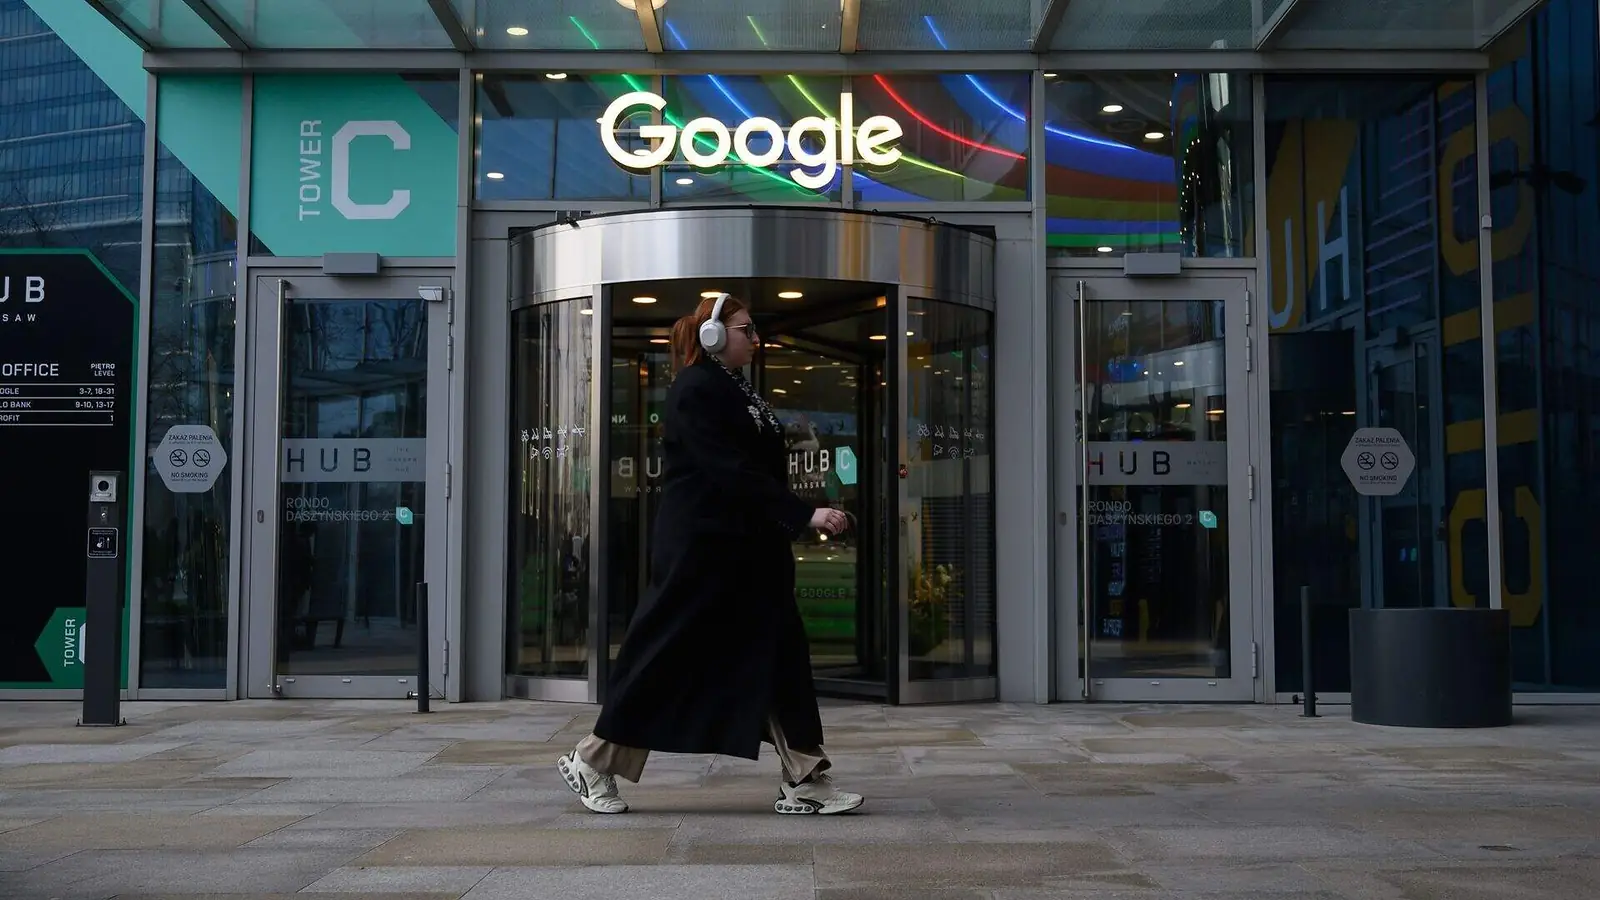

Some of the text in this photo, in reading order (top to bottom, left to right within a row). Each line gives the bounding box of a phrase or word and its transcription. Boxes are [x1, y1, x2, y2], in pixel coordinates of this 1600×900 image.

[599, 91, 903, 188] Google
[299, 120, 411, 221] TOWER C
[2, 363, 59, 376] OFFICE
[95, 387, 115, 395] 18-31
[286, 447, 371, 472] HUB
[789, 449, 850, 475] HUB C
[1087, 450, 1171, 476] HUB
[792, 481, 826, 490] WARSAW
[286, 497, 330, 509] RONDO
[1087, 501, 1132, 512] RONDO
[286, 508, 379, 521] DASZYŃSKIEGO
[382, 510, 391, 521] 2
[1087, 511, 1181, 525] DASZYŃSKIEGO
[1185, 514, 1193, 525] 2
[63, 618, 76, 667] TOWER
